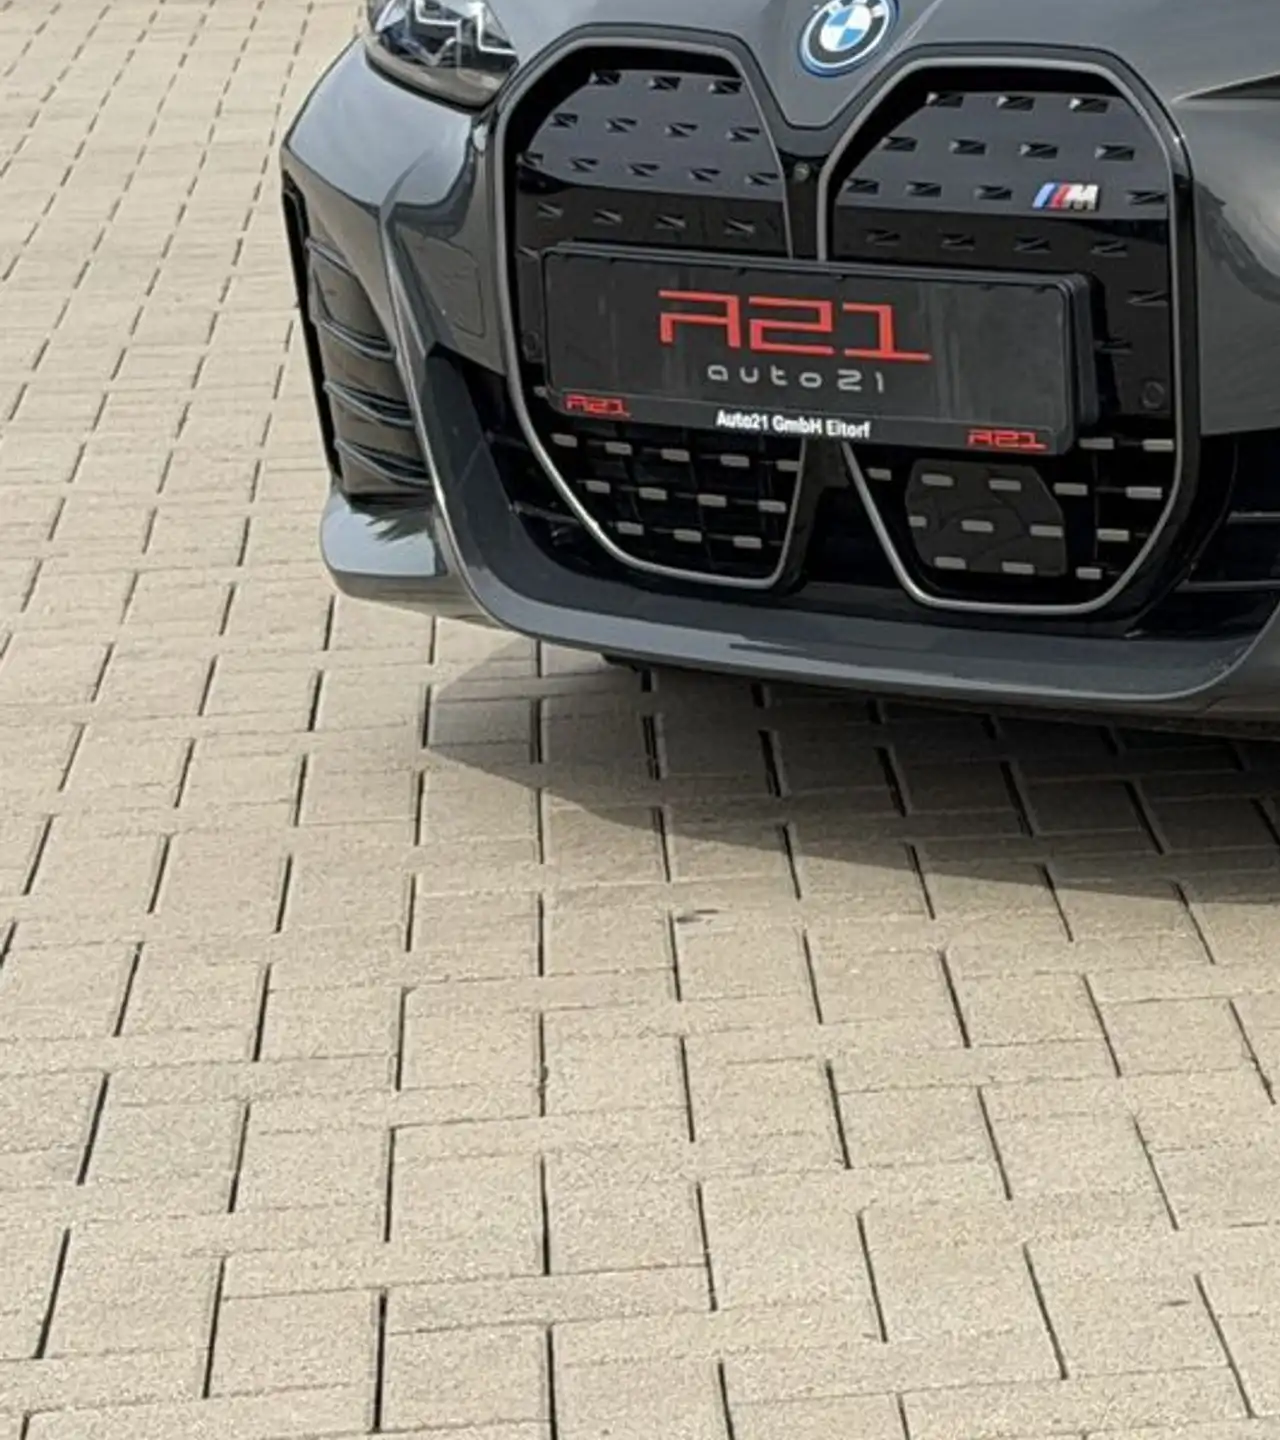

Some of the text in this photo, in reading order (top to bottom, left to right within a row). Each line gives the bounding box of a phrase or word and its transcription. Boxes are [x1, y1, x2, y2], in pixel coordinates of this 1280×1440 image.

[658, 289, 932, 361] A21
[715, 409, 768, 430] Auto21
[771, 415, 823, 435] GmbH
